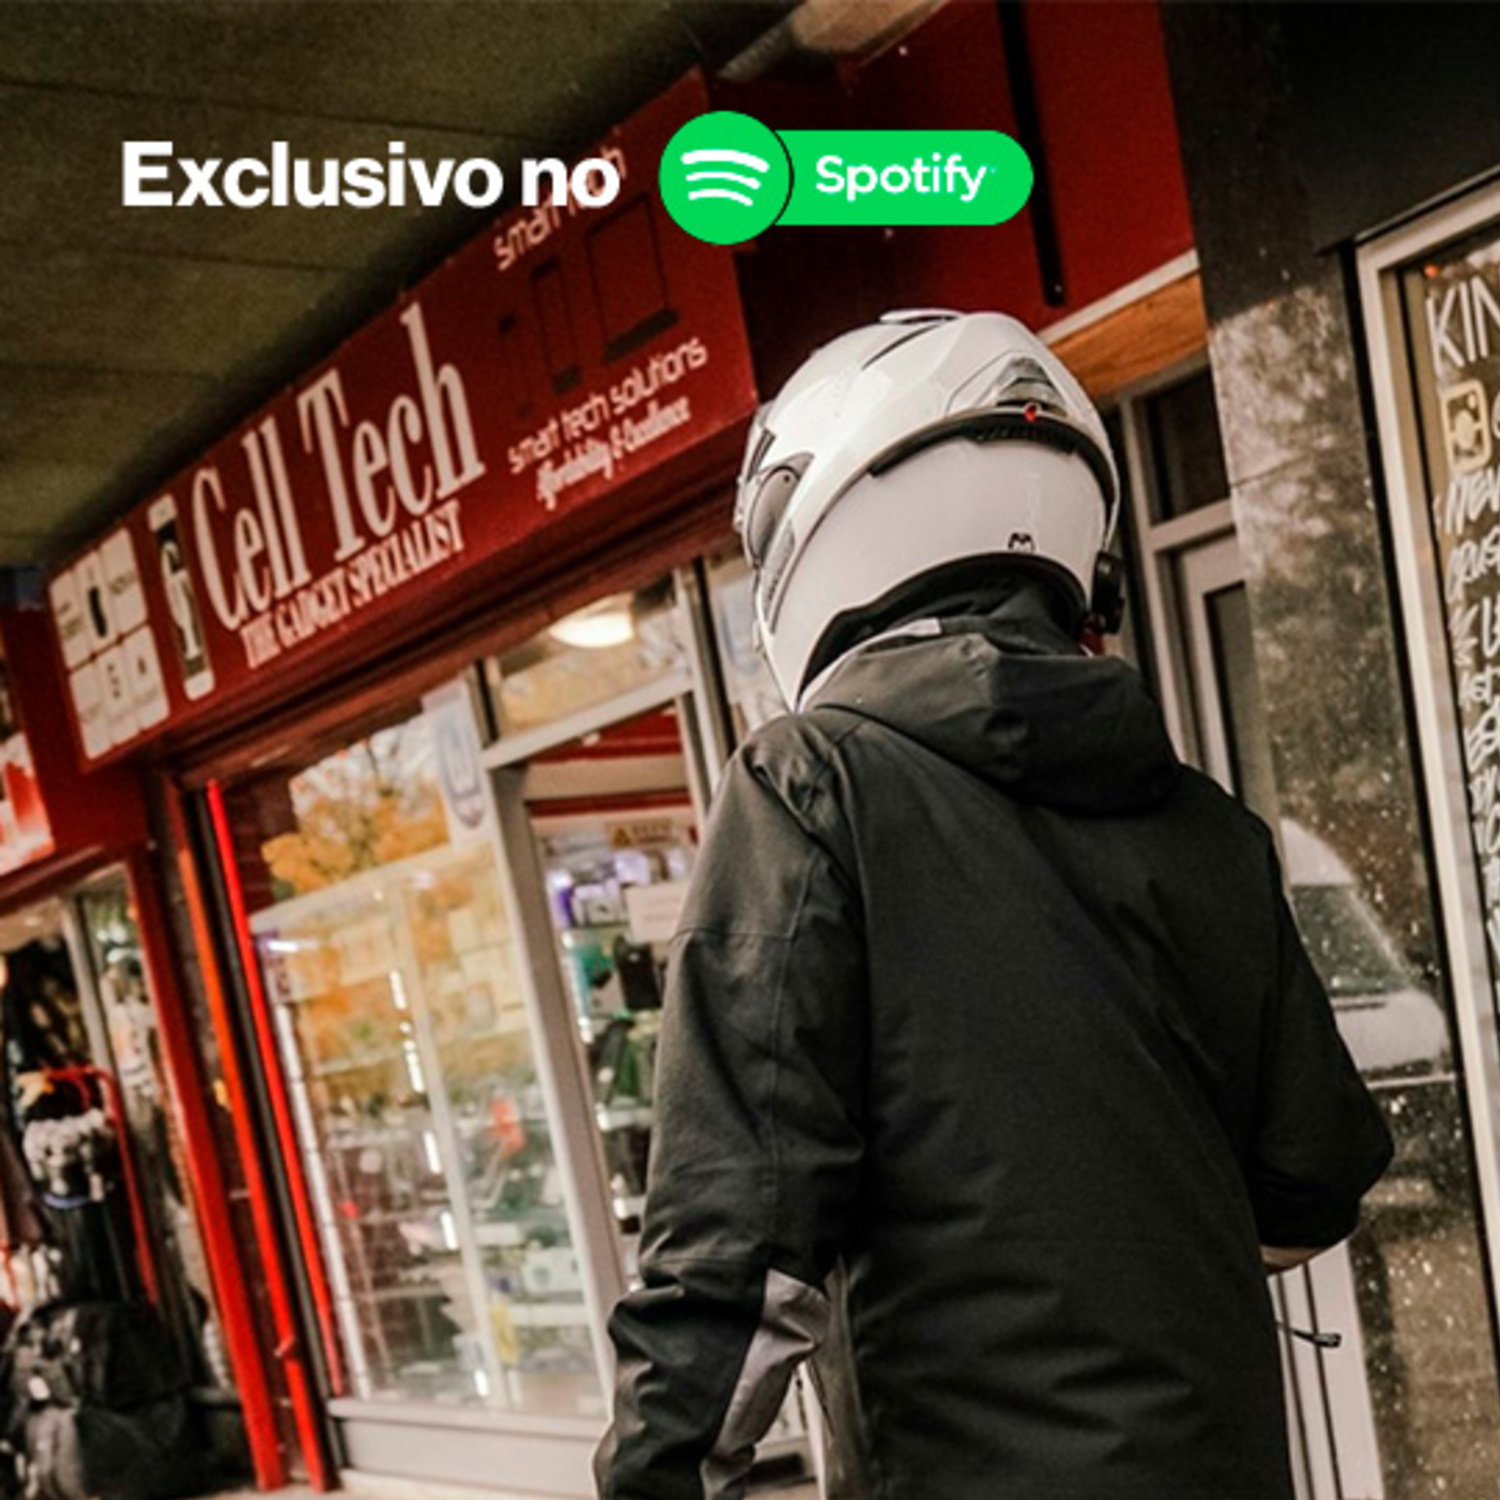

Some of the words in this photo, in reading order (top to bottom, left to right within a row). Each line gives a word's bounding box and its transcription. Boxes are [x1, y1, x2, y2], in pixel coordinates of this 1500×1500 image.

[192, 415, 312, 632] Cell
[297, 301, 485, 560] Tech
[610, 337, 708, 415] solutions
